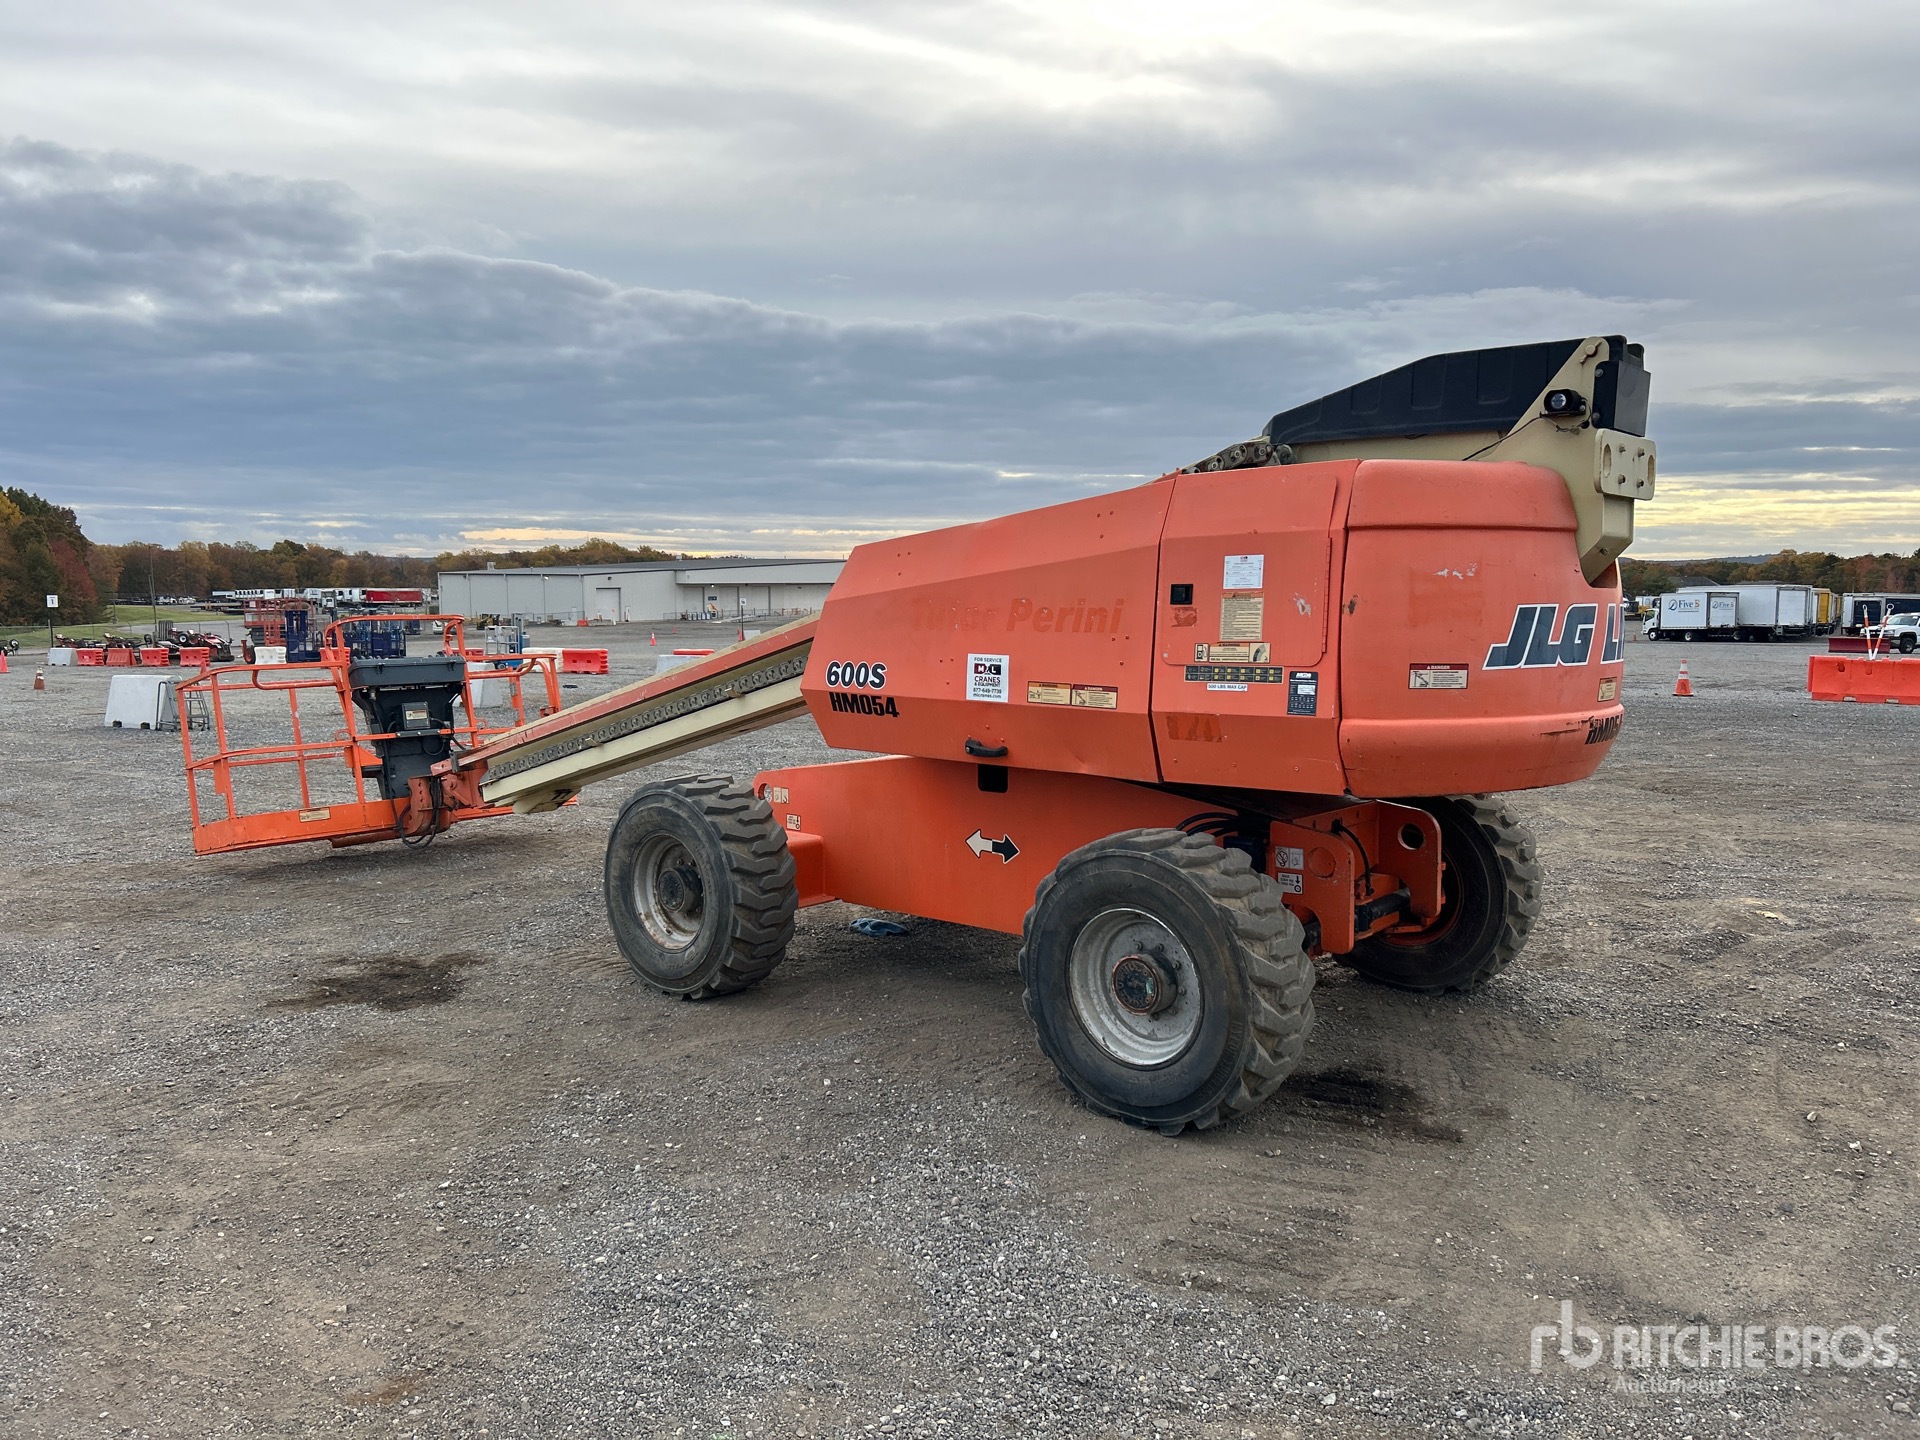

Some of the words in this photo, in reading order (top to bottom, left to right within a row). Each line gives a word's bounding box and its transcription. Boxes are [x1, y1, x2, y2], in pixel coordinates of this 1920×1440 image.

[1006, 598, 1125, 633] Perini
[1679, 600, 1693, 608] Five
[1482, 603, 1598, 670] JLG
[826, 660, 887, 690] 600S
[829, 692, 900, 718] HM054
